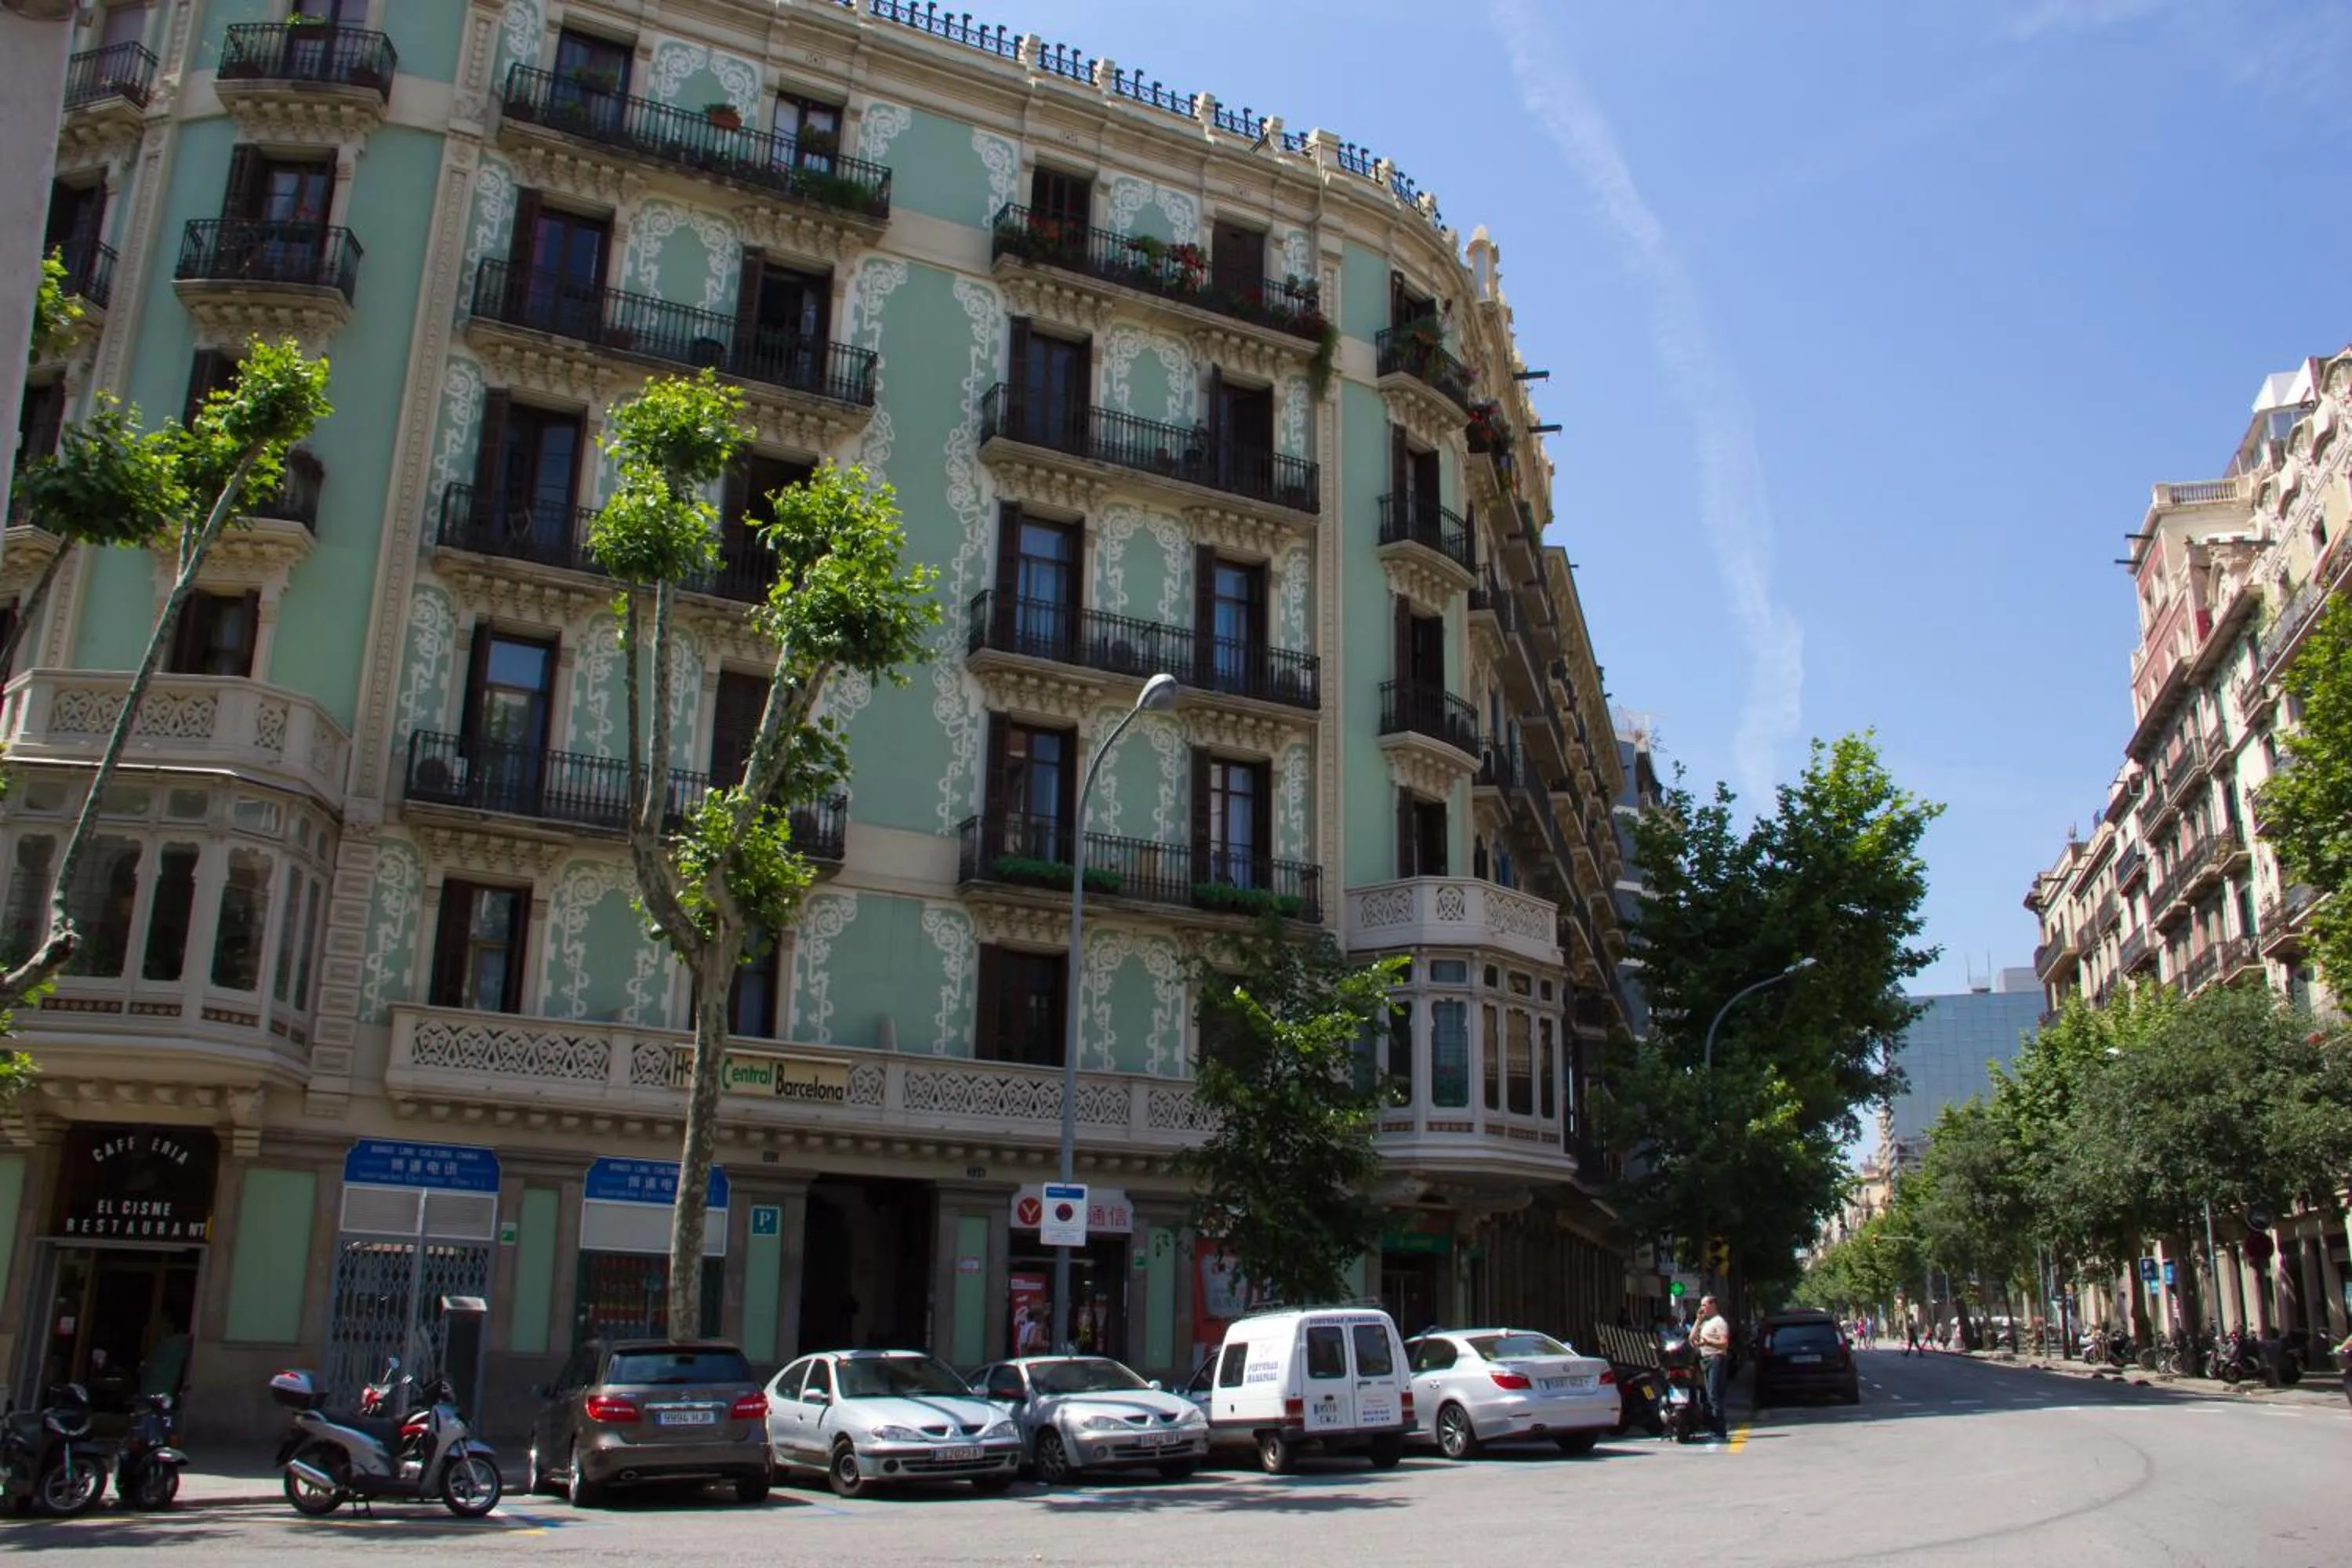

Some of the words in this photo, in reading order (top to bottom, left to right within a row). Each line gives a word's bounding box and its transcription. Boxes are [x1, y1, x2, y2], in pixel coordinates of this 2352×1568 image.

[721, 1058, 772, 1090] Central
[775, 1062, 844, 1101] Barcelona
[97, 1199, 113, 1214] EL
[122, 1200, 172, 1217] CISNE
[66, 1218, 205, 1237] RESTAURANT
[758, 1210, 771, 1227] P
